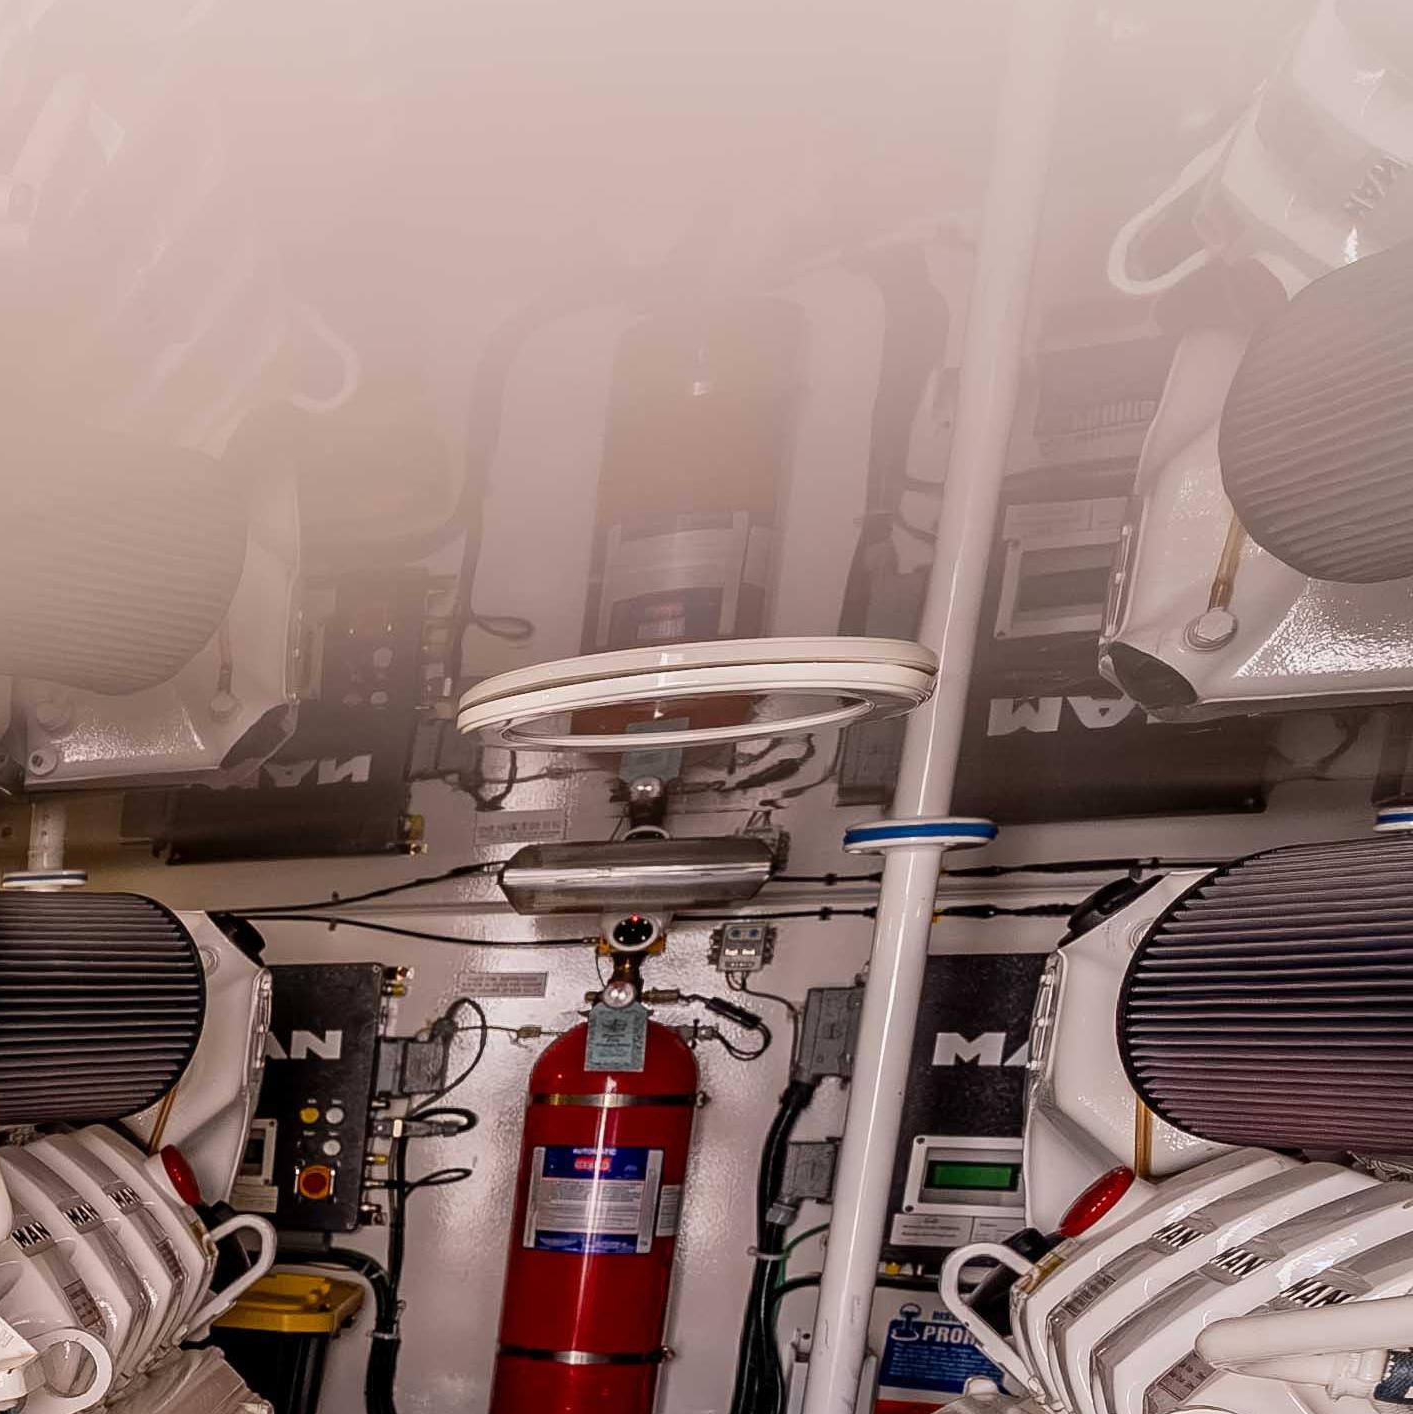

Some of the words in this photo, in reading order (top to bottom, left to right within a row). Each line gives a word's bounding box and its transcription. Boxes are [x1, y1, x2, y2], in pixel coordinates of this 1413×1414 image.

[108, 1187, 142, 1210] MAN
[63, 1202, 101, 1228] MAN
[10, 1221, 53, 1250] MAN
[1152, 1222, 1205, 1250] MAN
[1209, 1247, 1273, 1279] MAN
[1279, 1278, 1356, 1308] MAN
